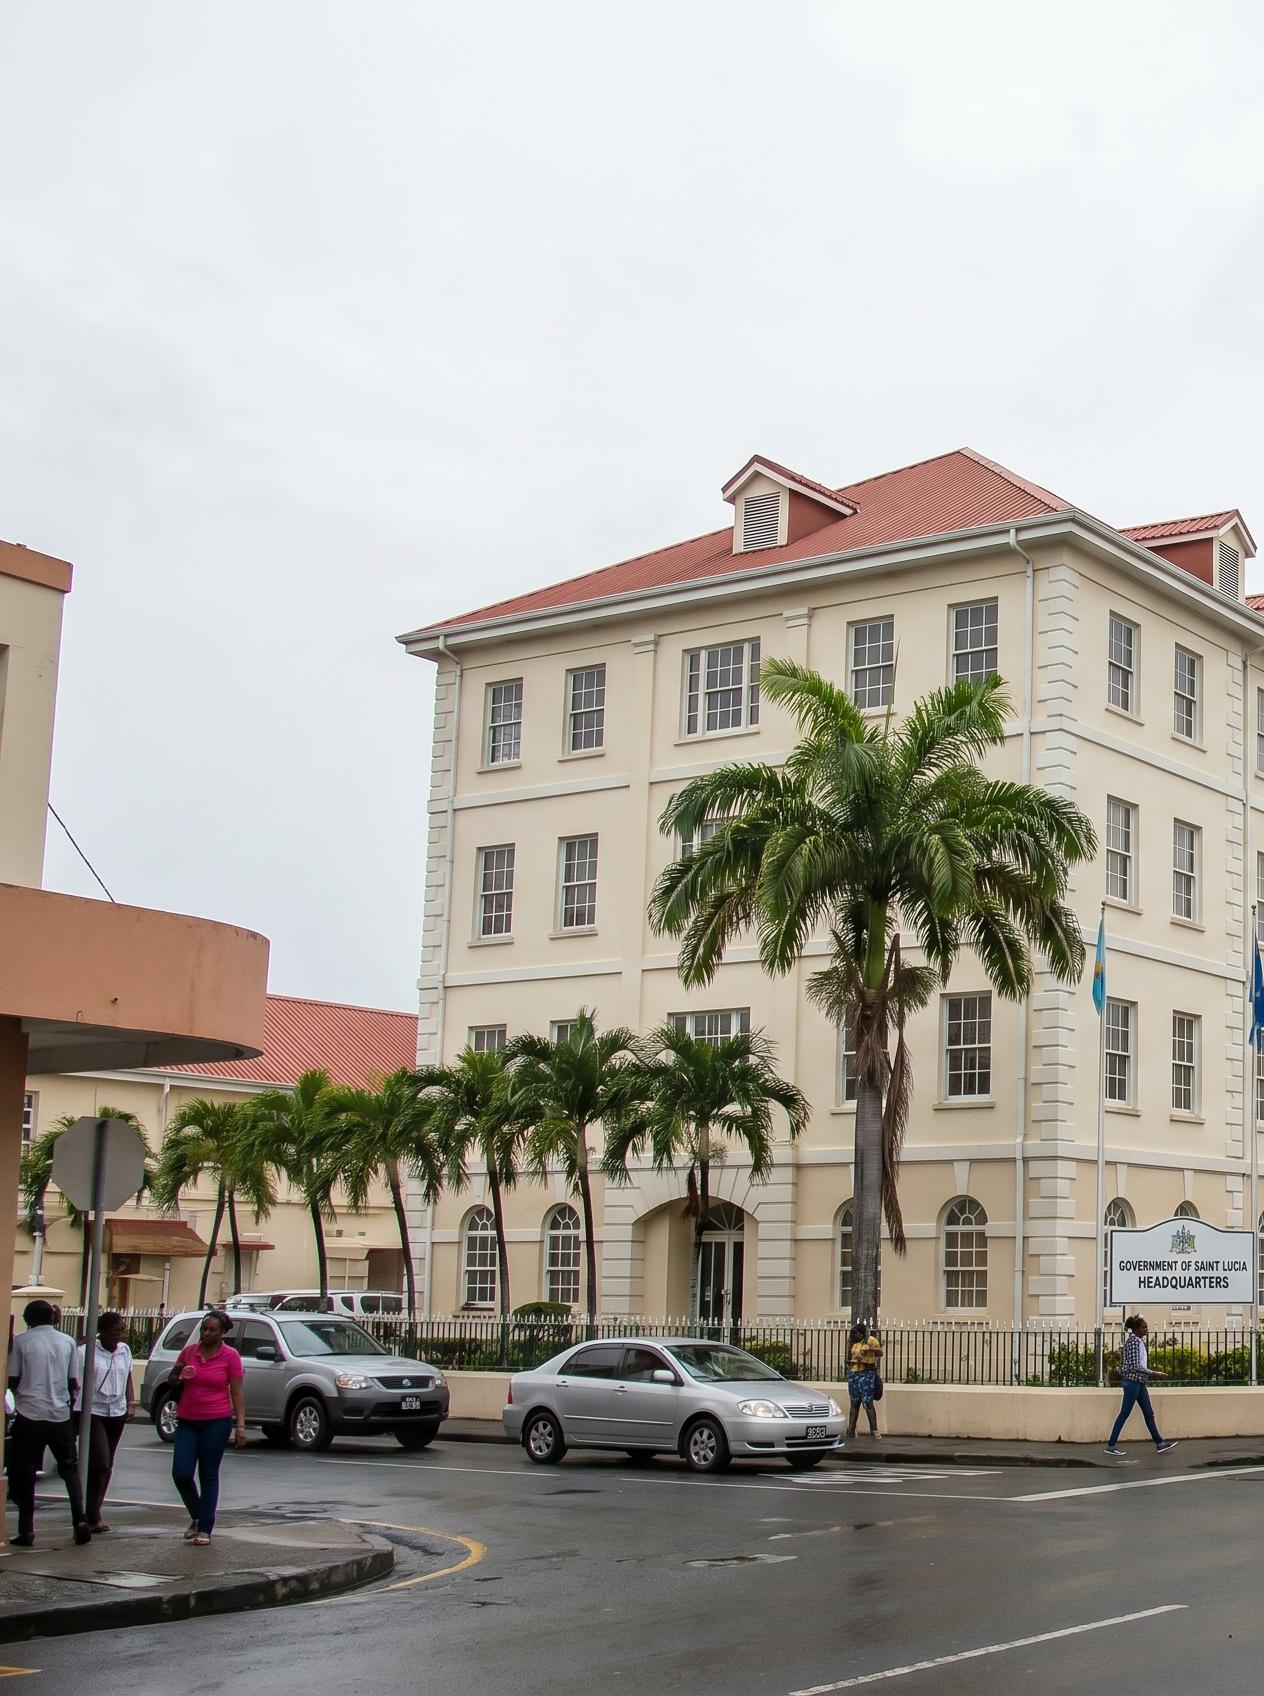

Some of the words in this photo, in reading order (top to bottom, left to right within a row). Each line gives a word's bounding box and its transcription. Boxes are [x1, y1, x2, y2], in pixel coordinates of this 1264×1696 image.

[1118, 1260, 1178, 1272] GOVERNMENT
[1180, 1260, 1192, 1272] OF
[1193, 1260, 1220, 1272] SAINT
[1222, 1260, 1248, 1272] LUCIA
[1138, 1276, 1229, 1290] HEADQUARTERS
